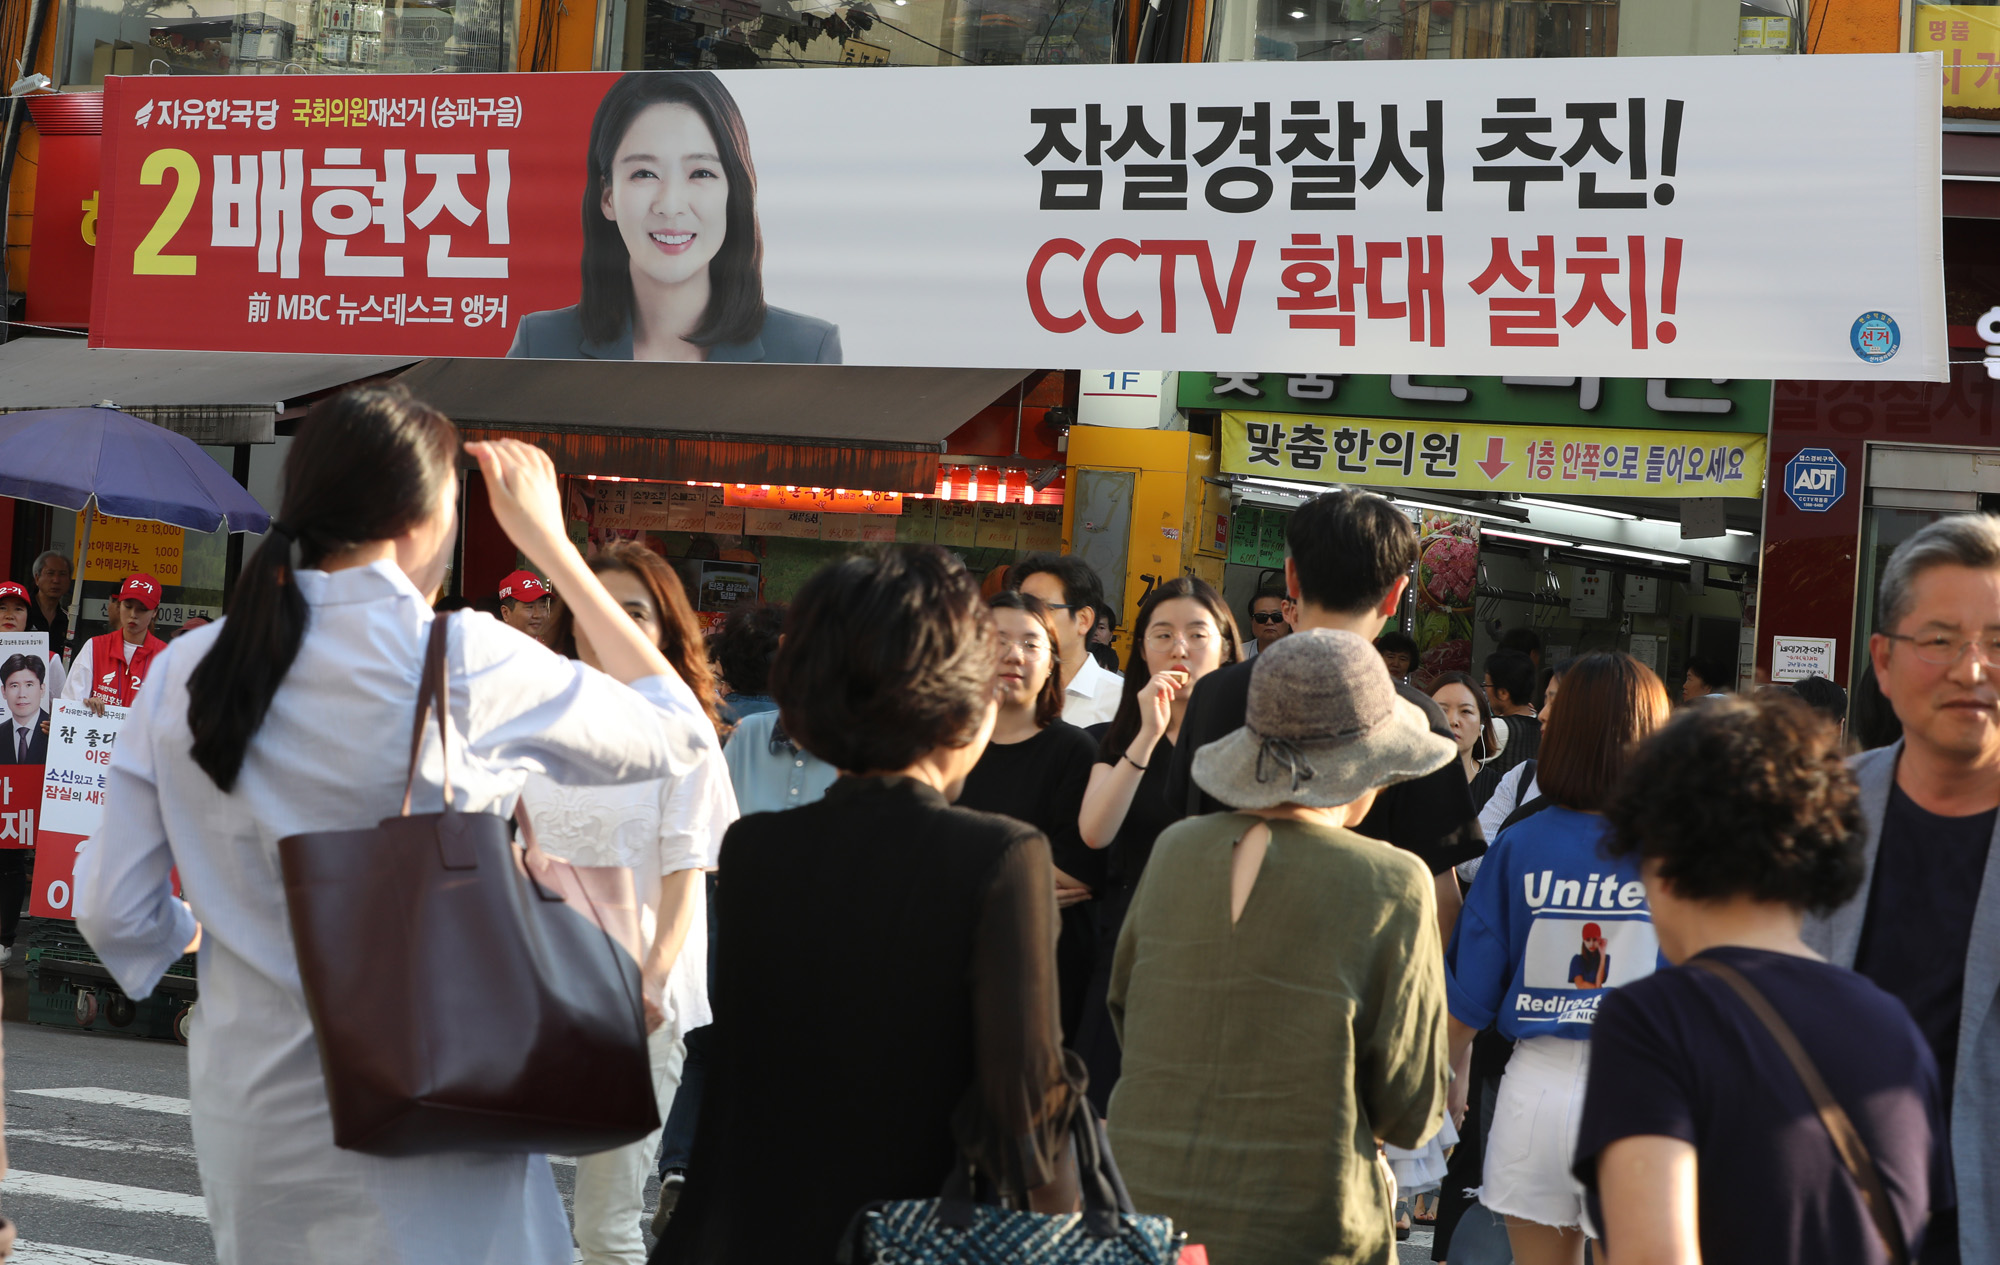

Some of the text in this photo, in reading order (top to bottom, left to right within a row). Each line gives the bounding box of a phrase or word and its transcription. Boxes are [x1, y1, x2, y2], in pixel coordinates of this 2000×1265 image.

[1929, 20, 1970, 41] 명품
[157, 96, 522, 130] 자유한국당 국회의원재선거 (송파구을)
[1024, 98, 1684, 213] 잠실경찰서 추진!
[133, 148, 200, 276] 2
[211, 148, 511, 279] 배현진
[1026, 233, 1684, 349] CCTV 확대 설치!
[248, 292, 508, 327] 前 MBC 뉴스데스크 앵커
[1860, 331, 1889, 347] 선거
[1103, 371, 1140, 390] 1F
[1247, 422, 1745, 484] 맞춤한의원 1층 안쪽으로 들어오세요
[1794, 469, 1836, 490] ADT
[942, 504, 973, 518] 생갈비
[152, 524, 180, 535] 13,000
[155, 547, 179, 557] 1,000
[95, 558, 140, 572] 아메리카노
[153, 564, 178, 575] 1,500
[130, 580, 153, 594] 2-가
[60, 726, 77, 744] 참
[46, 768, 93, 786] 소신있고
[45, 784, 82, 802] 잠실의
